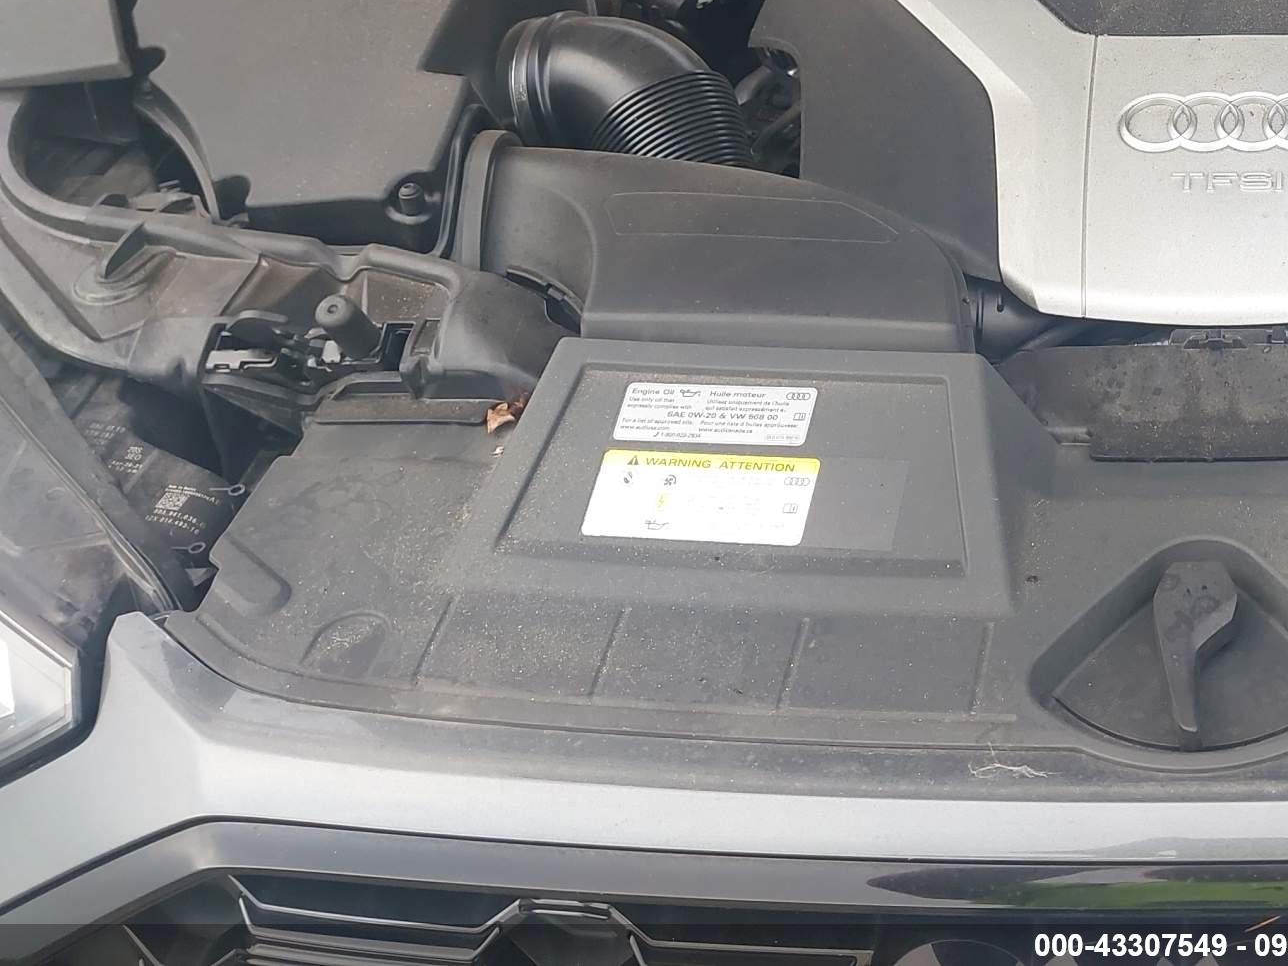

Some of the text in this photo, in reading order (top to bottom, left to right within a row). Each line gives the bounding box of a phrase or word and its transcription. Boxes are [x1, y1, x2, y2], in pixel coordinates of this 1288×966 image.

[1171, 171, 1284, 193] TFSI
[632, 388, 660, 396] Engine
[710, 390, 731, 398] Huile
[646, 457, 796, 473] WARNING ATTENTION
